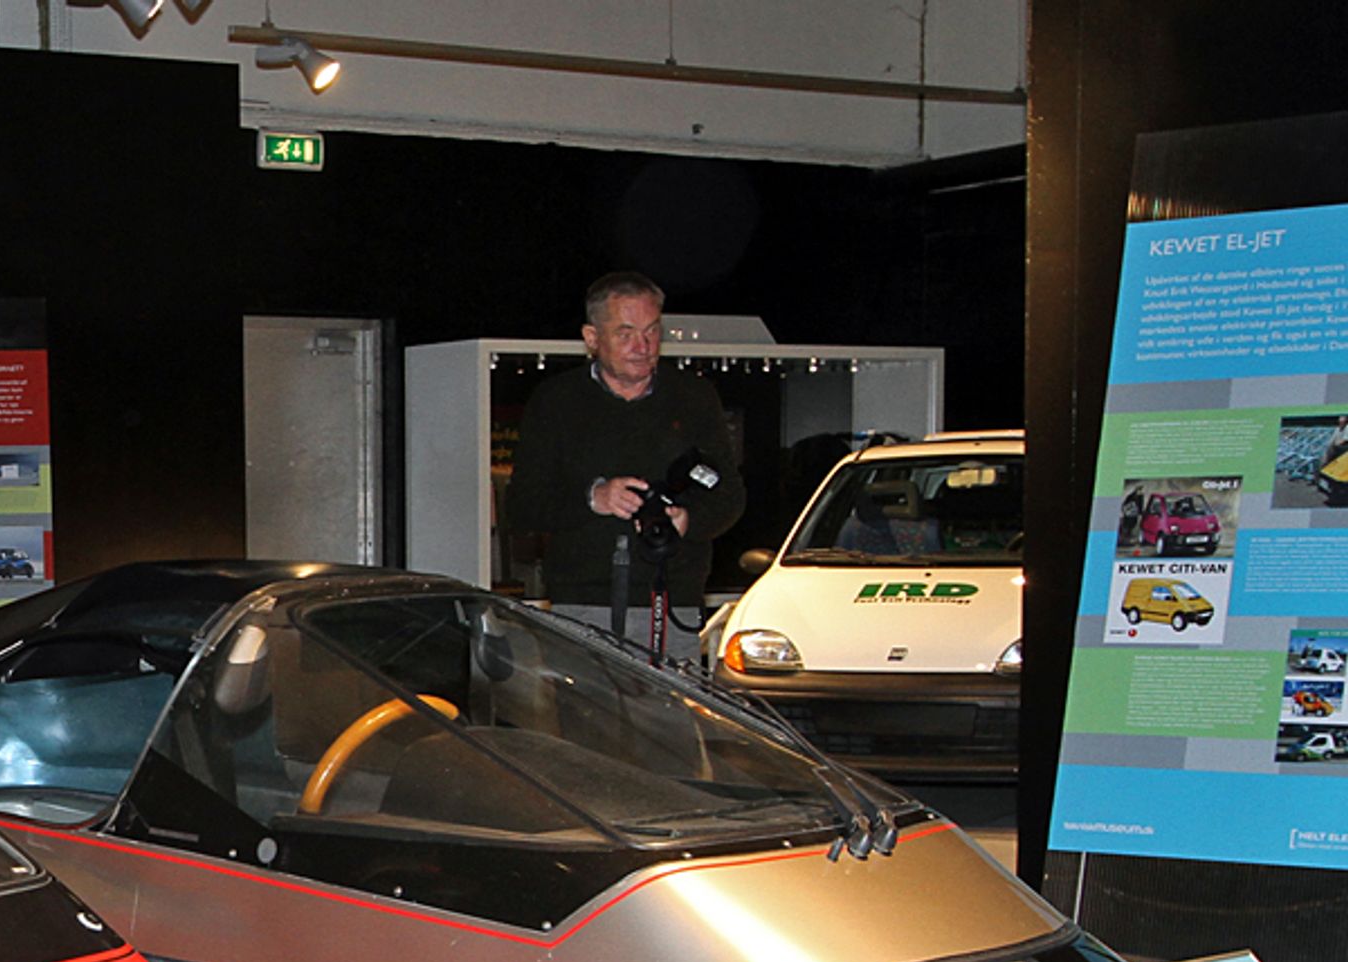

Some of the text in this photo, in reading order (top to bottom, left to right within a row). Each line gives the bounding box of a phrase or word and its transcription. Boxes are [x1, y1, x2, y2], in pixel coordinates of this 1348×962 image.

[1149, 229, 1287, 257] KEWET EL-JET
[1118, 563, 1228, 574] KEWET CITI-VAN
[858, 582, 980, 598] IRD
